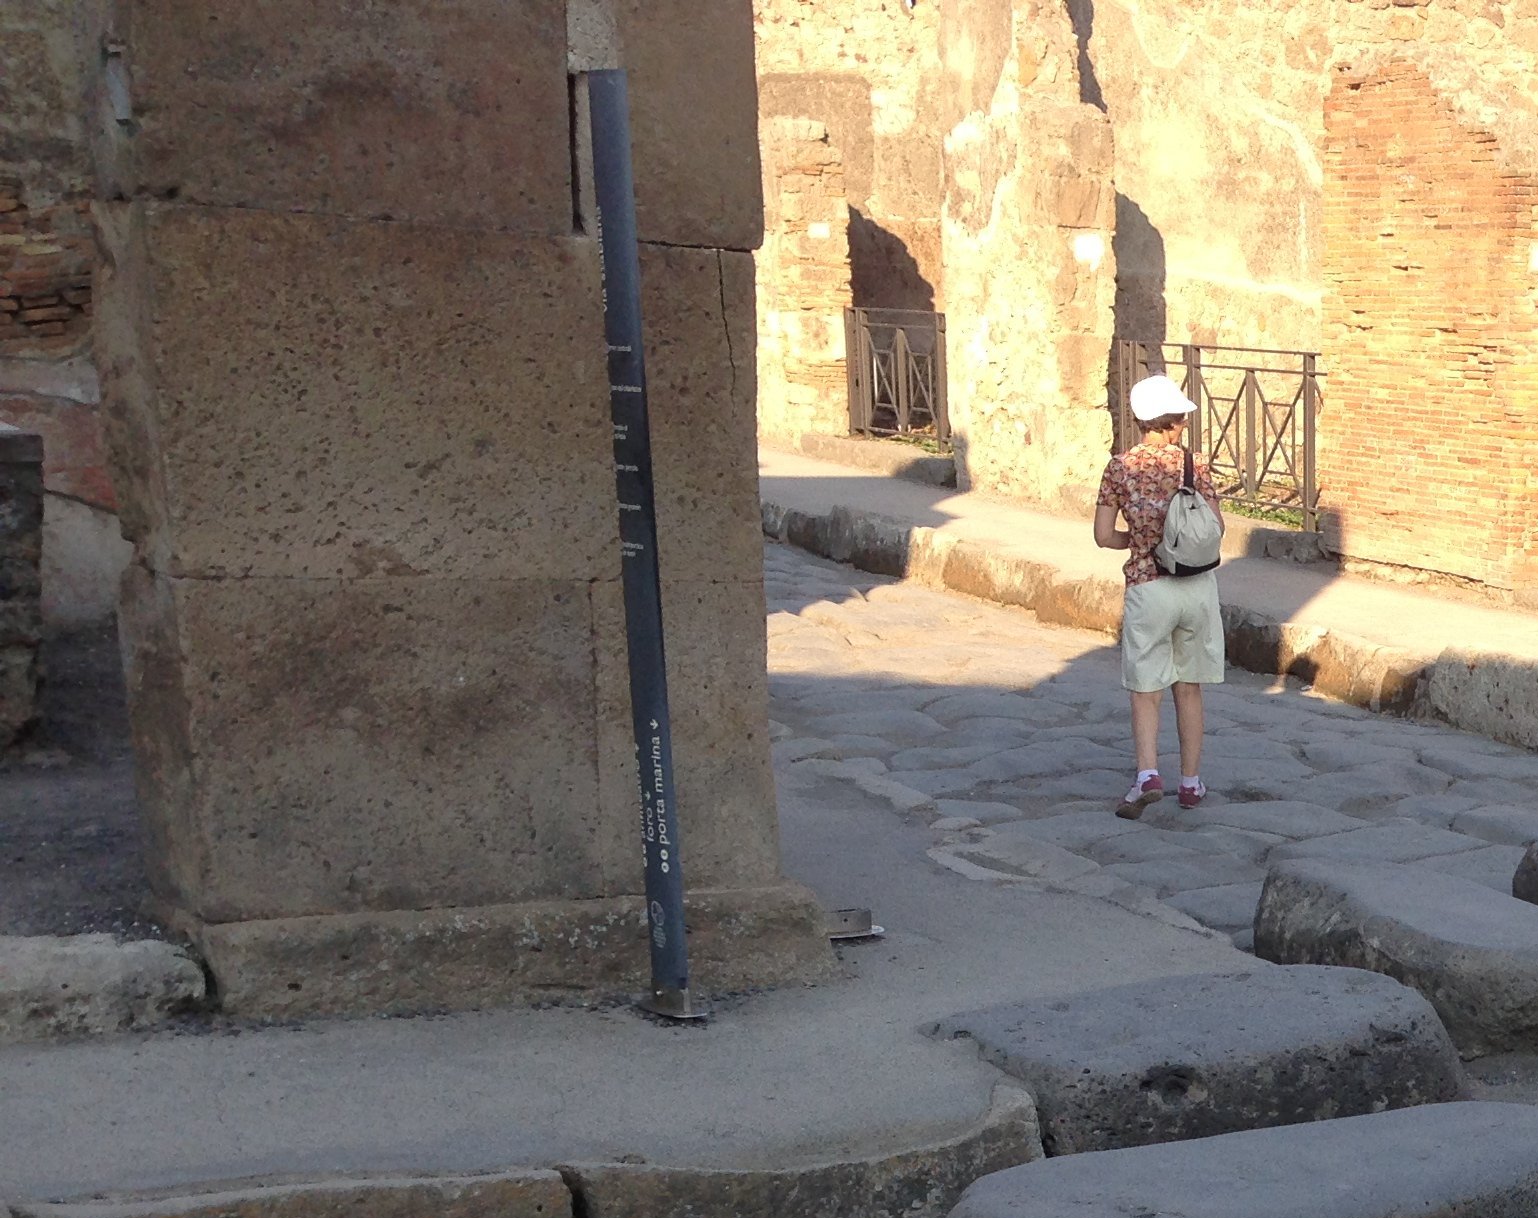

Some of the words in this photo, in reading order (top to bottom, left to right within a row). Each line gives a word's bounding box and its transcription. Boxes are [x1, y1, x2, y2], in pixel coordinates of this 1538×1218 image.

[651, 736, 664, 793] marina
[645, 806, 655, 843] foro
[656, 799, 670, 845] porta
